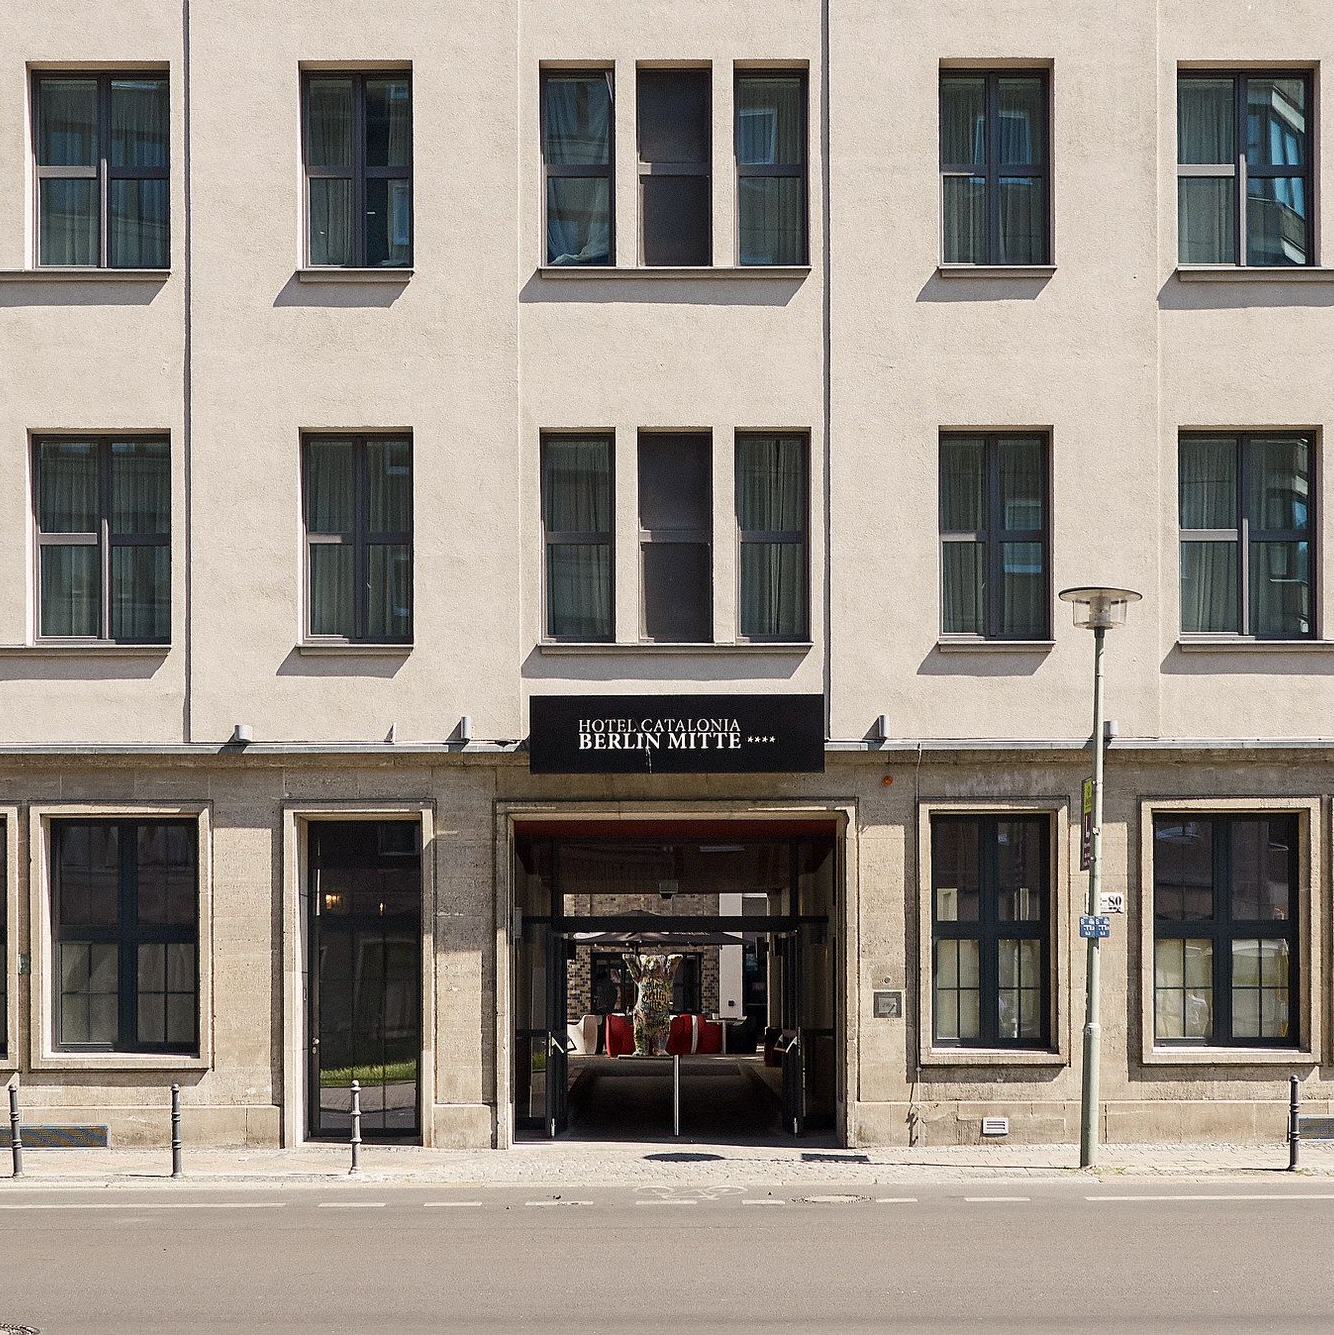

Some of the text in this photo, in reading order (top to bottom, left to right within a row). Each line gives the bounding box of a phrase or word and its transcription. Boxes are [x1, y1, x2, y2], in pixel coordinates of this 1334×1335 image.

[579, 718, 741, 733] HOTEL CATALONIA
[579, 732, 742, 750] BERLIN MITTE
